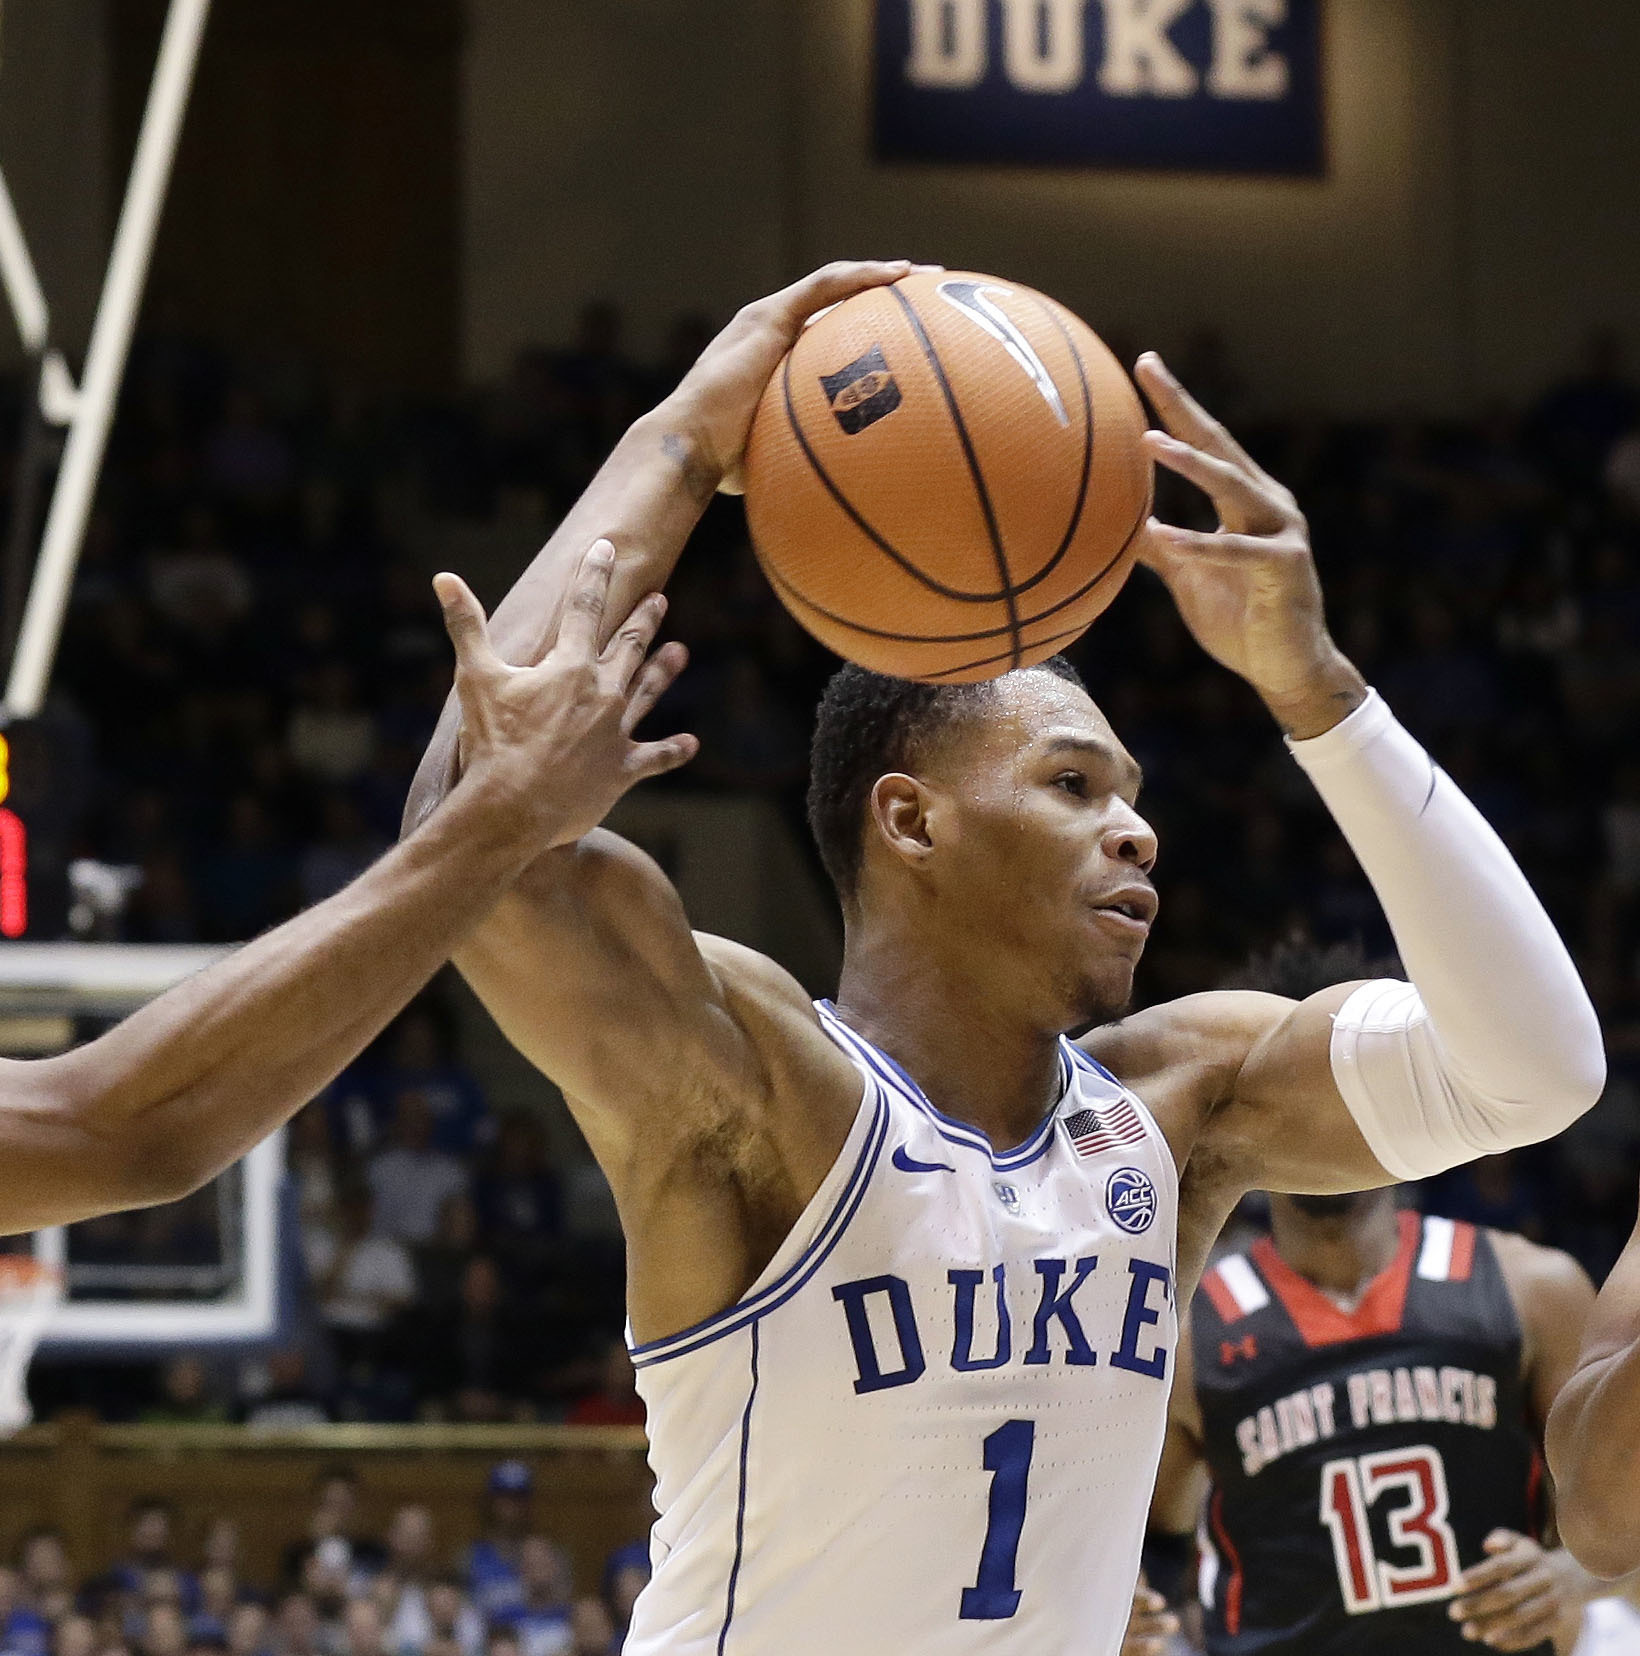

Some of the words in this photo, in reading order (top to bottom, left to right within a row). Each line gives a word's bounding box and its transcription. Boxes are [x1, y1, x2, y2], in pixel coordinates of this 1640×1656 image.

[905, 0, 1290, 98] DUKE
[1115, 1185, 1152, 1206] ACC
[831, 1254, 1172, 1396] DUKE
[1235, 1381, 1335, 1477] SAINT
[1346, 1366, 1497, 1430] FRANCIS
[959, 1419, 1036, 1620] 1
[1320, 1444, 1462, 1615] 13
